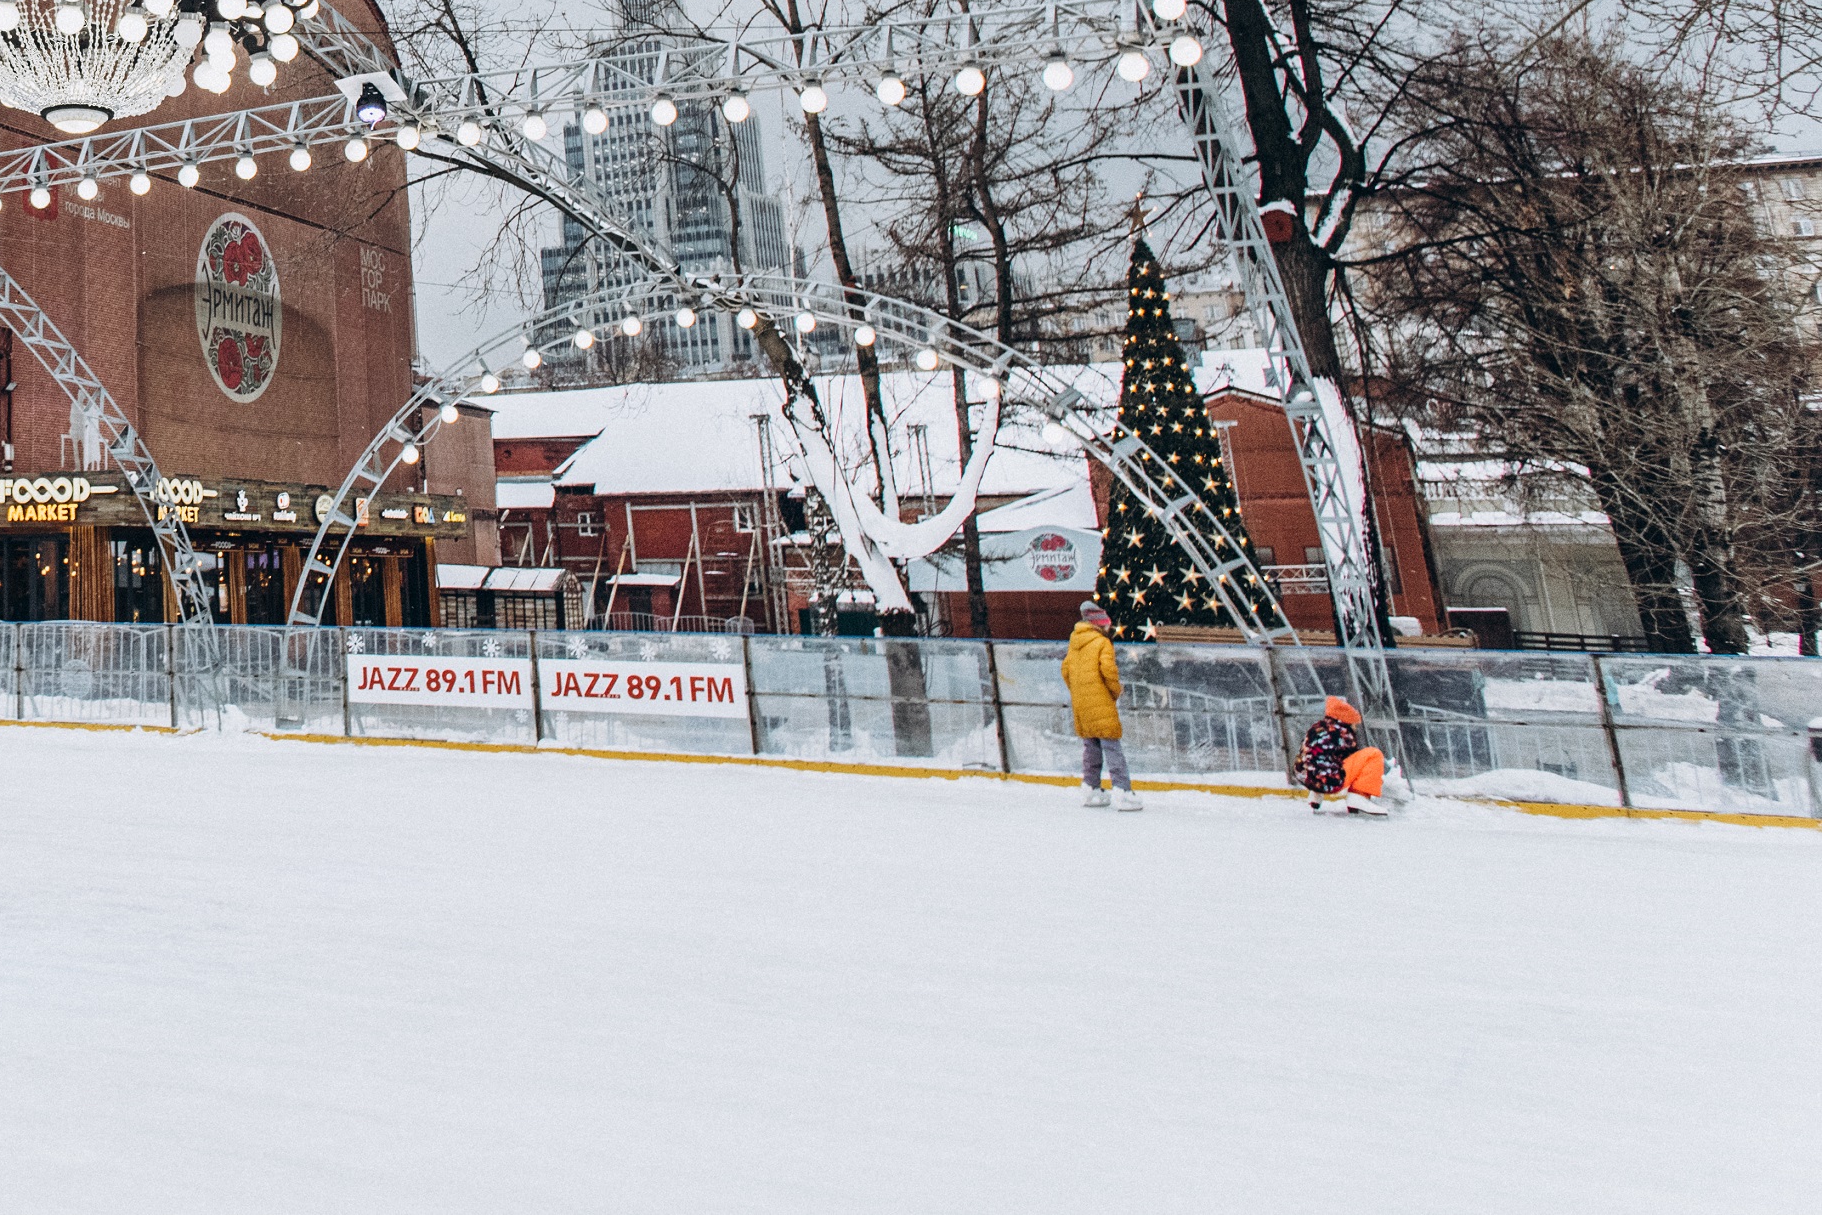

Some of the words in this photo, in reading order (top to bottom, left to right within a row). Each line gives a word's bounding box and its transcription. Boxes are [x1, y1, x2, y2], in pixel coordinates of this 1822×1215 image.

[98, 207, 131, 229] Москвы
[360, 245, 385, 272] МОС
[361, 268, 384, 288] ГОР
[362, 287, 392, 313] ПАРК
[7, 503, 78, 522] MARKET
[358, 667, 419, 692] JAZZ
[426, 669, 475, 694] 89.1
[482, 670, 521, 695] FM
[551, 672, 620, 698] JAZZ
[627, 675, 682, 701] 89.1
[689, 676, 734, 703] FM
